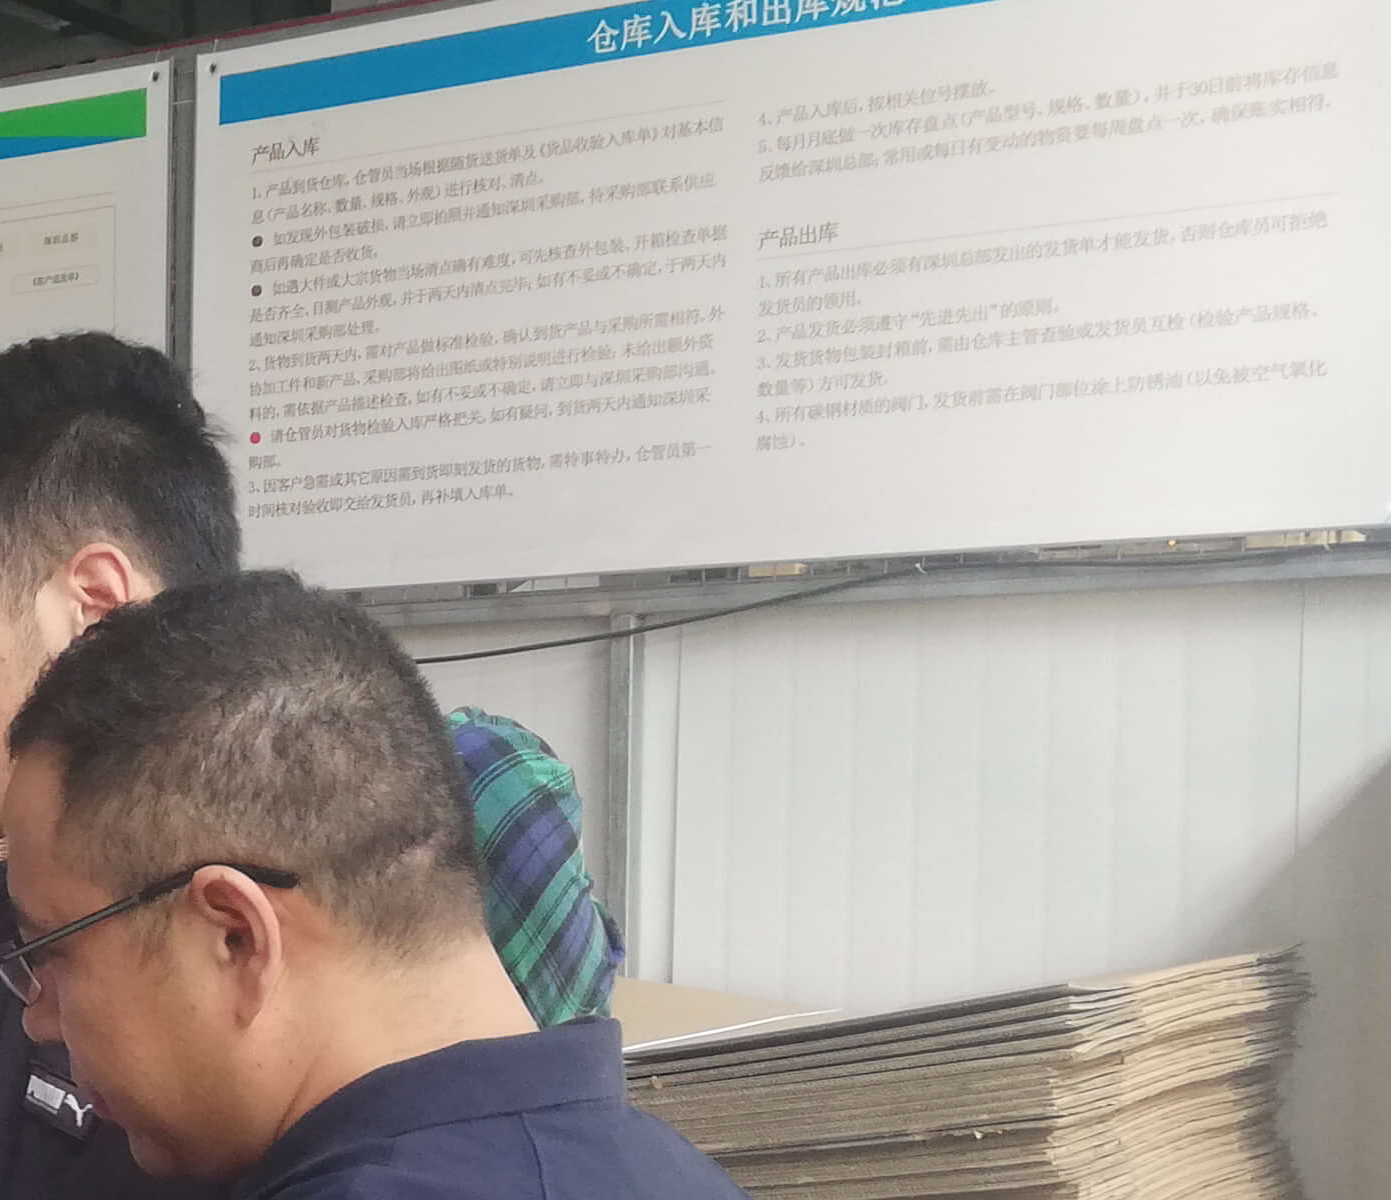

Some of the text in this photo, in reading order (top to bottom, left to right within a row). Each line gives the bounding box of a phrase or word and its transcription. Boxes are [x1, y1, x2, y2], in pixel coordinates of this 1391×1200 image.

[252, 136, 320, 165] 产品入库
[758, 221, 839, 250] 产品出库
